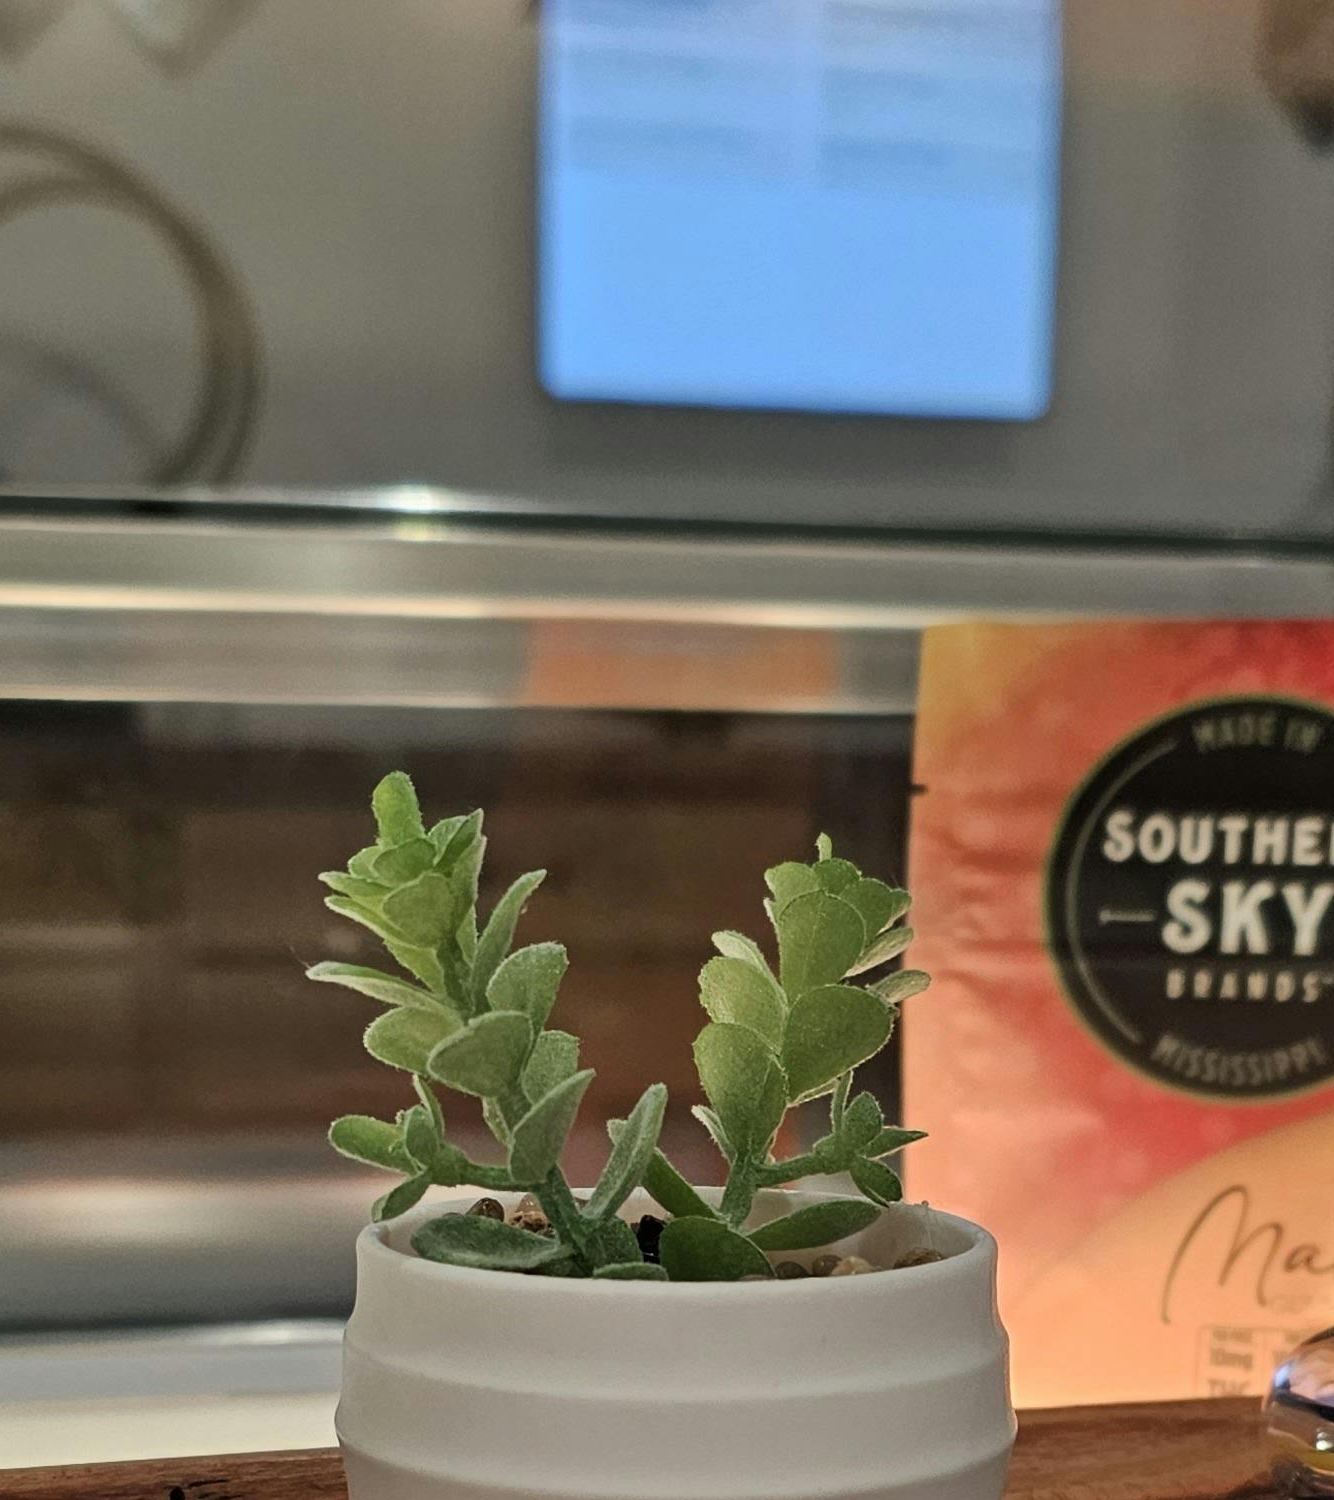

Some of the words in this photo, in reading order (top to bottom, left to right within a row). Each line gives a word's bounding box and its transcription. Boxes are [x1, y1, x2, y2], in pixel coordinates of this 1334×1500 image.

[1191, 712, 1276, 753] MADE
[1282, 717, 1324, 754] IN
[1151, 1034, 1326, 1086] MISSISSIPPI
